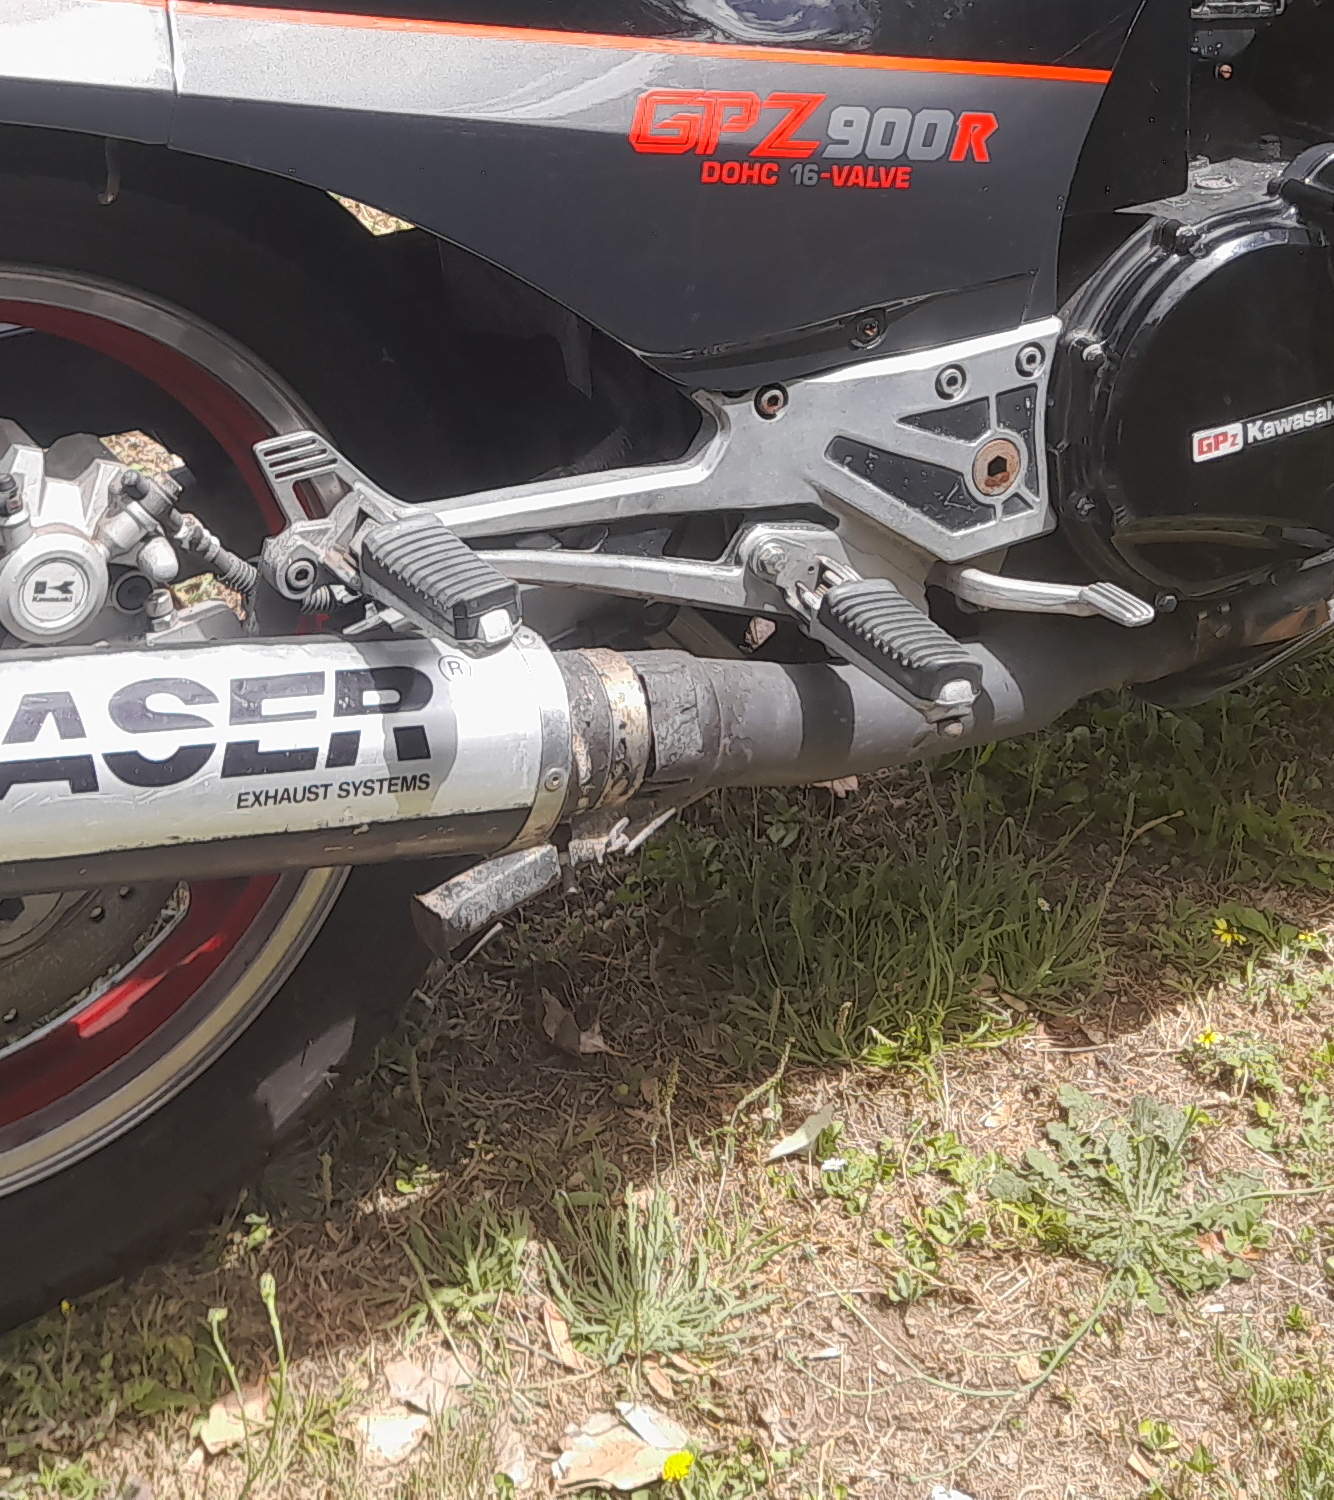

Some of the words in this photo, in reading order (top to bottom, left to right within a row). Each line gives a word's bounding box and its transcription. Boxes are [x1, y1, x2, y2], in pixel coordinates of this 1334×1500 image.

[700, 160, 779, 185] DOHC
[788, 162, 912, 189] 16-VALVE
[236, 783, 330, 810] EXHAUST
[336, 772, 431, 800] SYSTEMS
